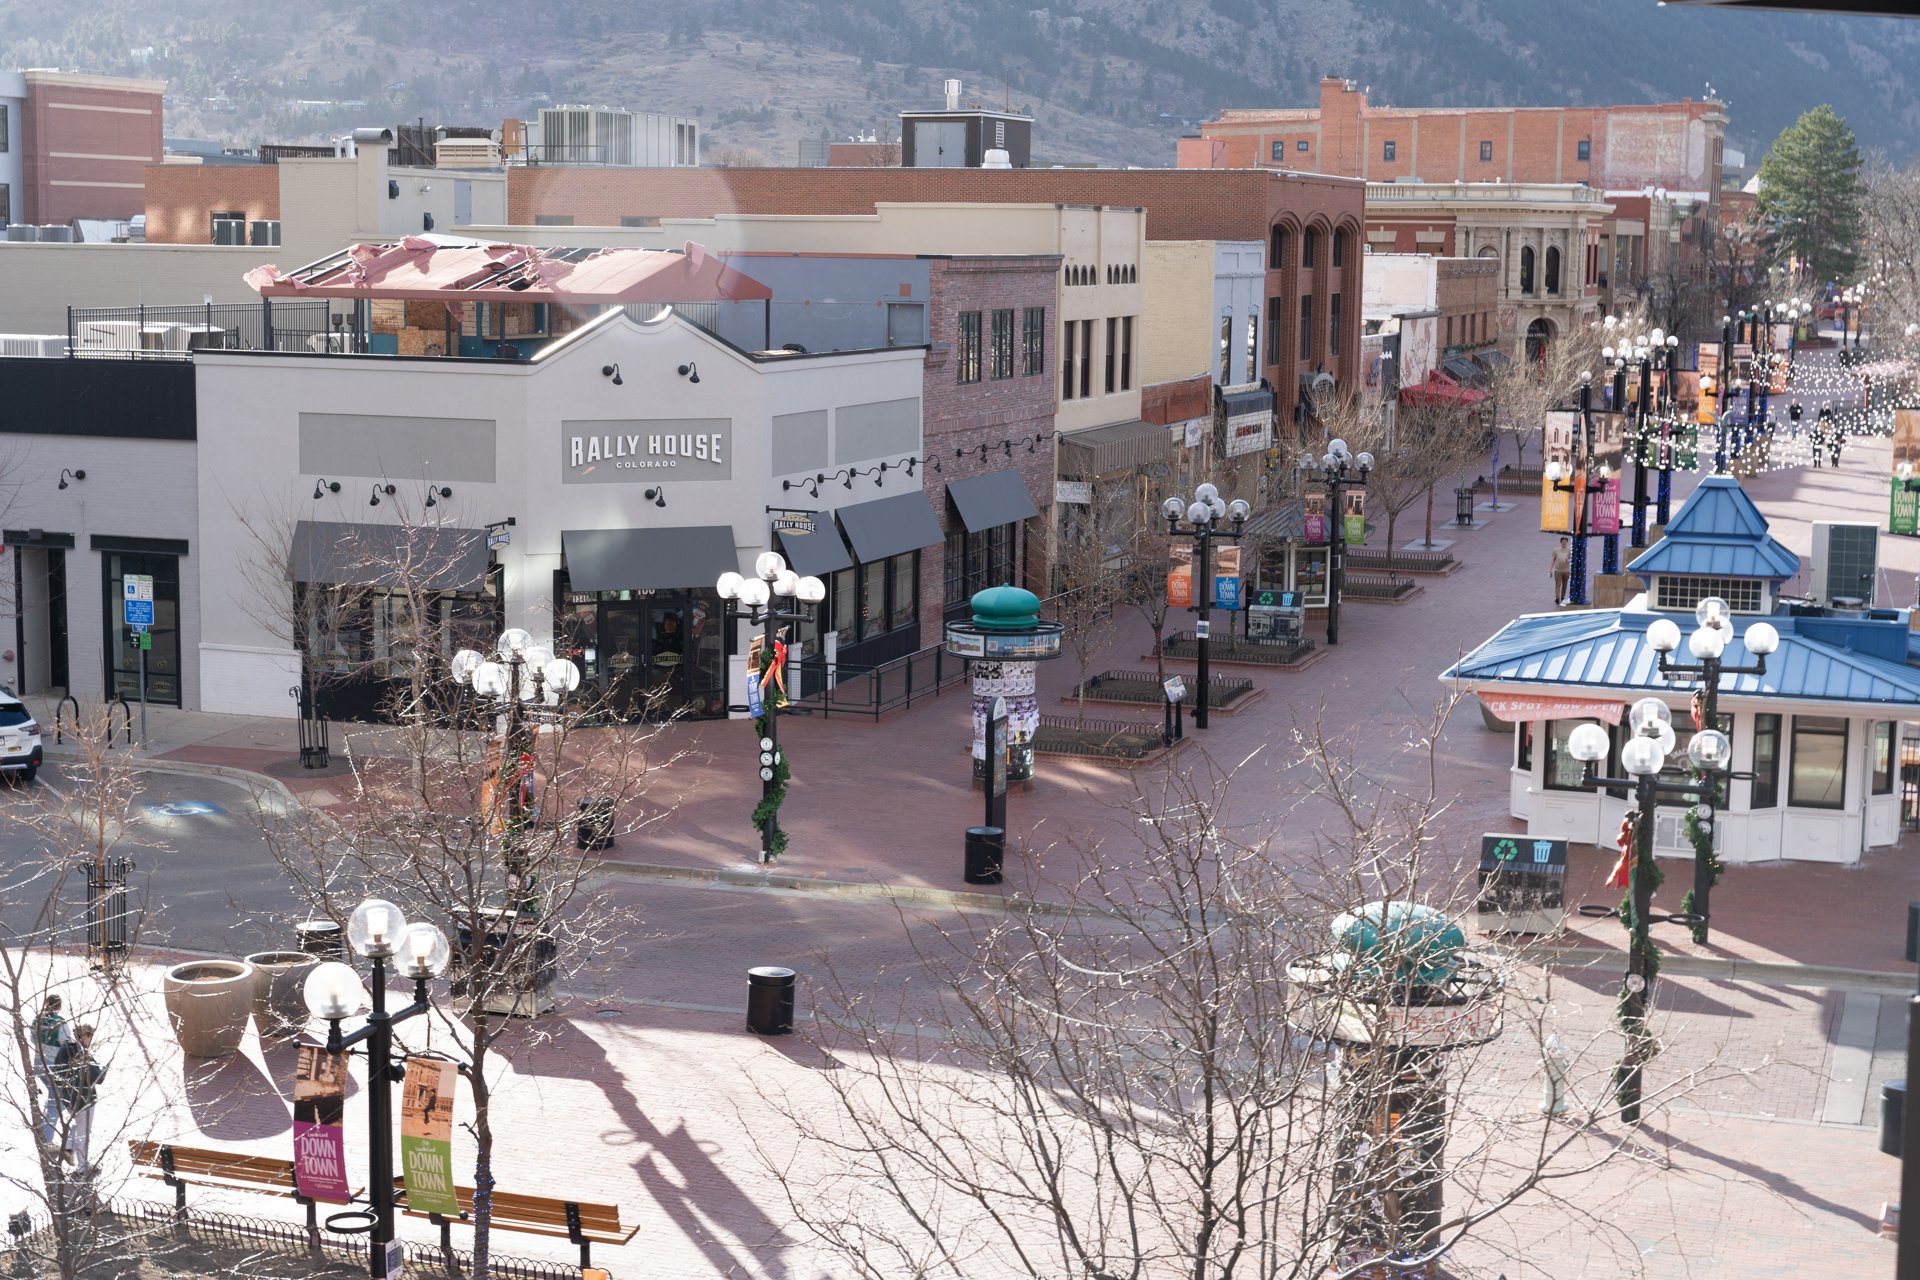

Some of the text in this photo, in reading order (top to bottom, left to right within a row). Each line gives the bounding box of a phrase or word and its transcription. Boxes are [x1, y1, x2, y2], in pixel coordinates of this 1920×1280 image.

[571, 433, 722, 467] RALLY HOUSE
[616, 460, 676, 469] COLORADO
[1596, 491, 1617, 504] DOWN
[1894, 490, 1917, 503] DOWN
[1596, 504, 1617, 518] TOWN
[1894, 502, 1916, 517] TOWN
[774, 520, 816, 532] RALLY HOUSE
[1171, 581, 1188, 590] DOWN
[1218, 582, 1236, 591] DOWN
[1172, 589, 1188, 598] TOWN
[1219, 590, 1236, 599] TOWN
[1680, 673, 1698, 681] STREET
[1510, 701, 1542, 710] SPOT
[1584, 703, 1623, 714] OPEN!
[301, 1136, 337, 1160] DOWN
[303, 1156, 339, 1178] TOWN
[408, 1150, 444, 1174] DOWN
[410, 1170, 447, 1193] TOWN
